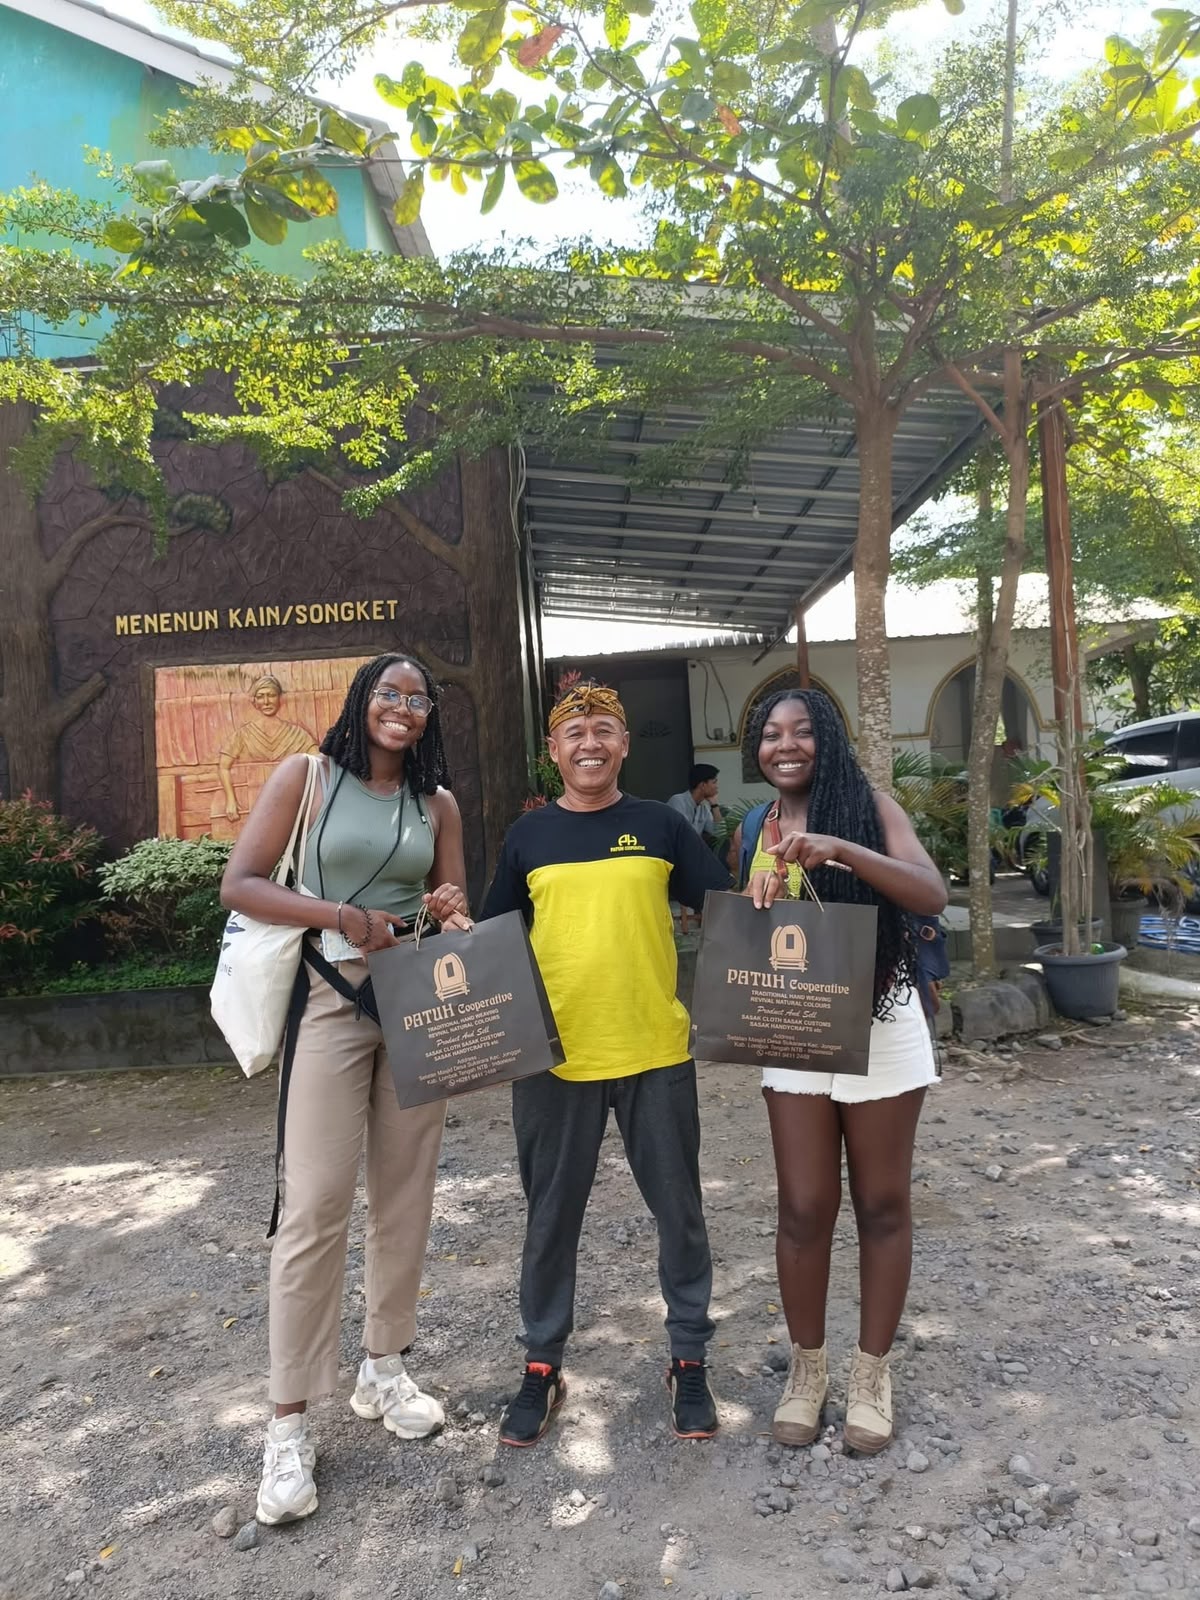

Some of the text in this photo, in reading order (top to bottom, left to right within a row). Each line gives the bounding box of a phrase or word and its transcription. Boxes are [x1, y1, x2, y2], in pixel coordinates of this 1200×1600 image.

[115, 600, 399, 636] MENENUN KAIN/SONGKET
[727, 968, 850, 994] PATUH Cooperative
[751, 990, 788, 998] TRADITIONAL
[403, 992, 513, 1030] PATUH Cooperative
[757, 1005, 818, 1019] Product And Sell
[803, 1001, 831, 1009] COLOURS
[427, 1008, 499, 1033] TRADITIONAL HAND WEAVING
[428, 1015, 500, 1039] REVIVAL NATURAL COLOURS
[770, 1023, 813, 1032] HANDYCRAFTS
[804, 1020, 831, 1028] CUSTOMS
[425, 1031, 506, 1058] SASAK CLOTH SASAK CUSTOMS
[436, 1026, 490, 1047] Product And Sell
[434, 1053, 452, 1062] SASAK
[452, 1041, 491, 1056] HANDYCRAFTS
[477, 1063, 488, 1071] NTB
